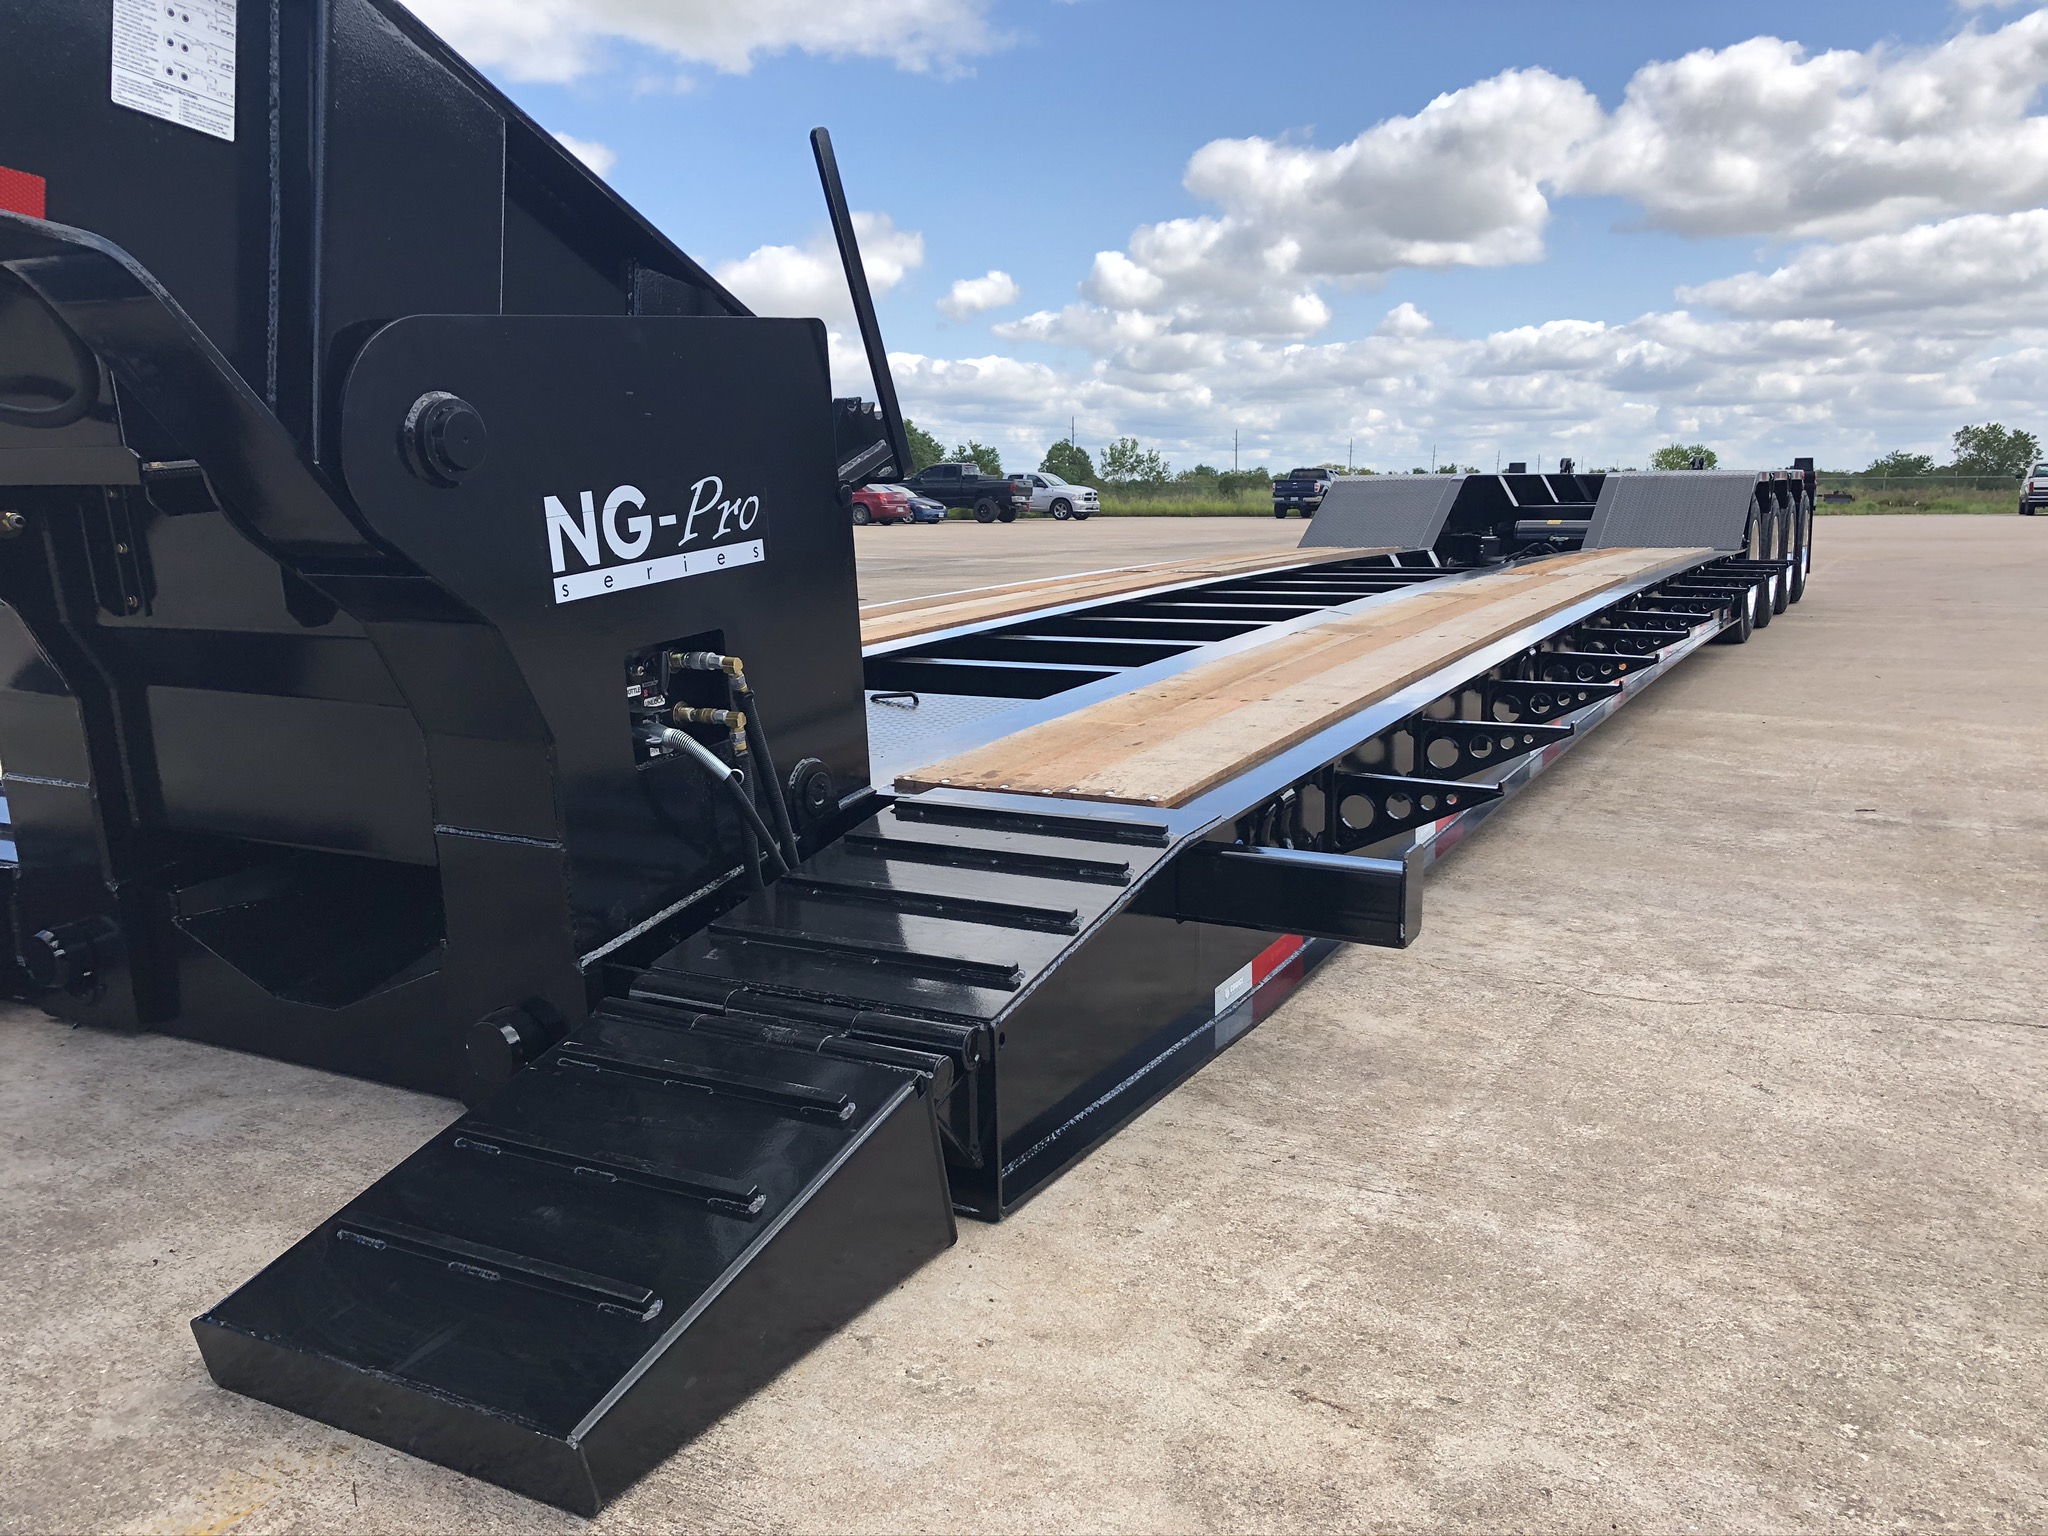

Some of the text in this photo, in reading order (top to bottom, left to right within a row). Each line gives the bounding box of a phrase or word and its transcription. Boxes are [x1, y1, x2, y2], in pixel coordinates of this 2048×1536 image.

[543, 475, 759, 573] NG-Pro
[561, 546, 759, 597] series
[627, 686, 640, 695] OTTLE
